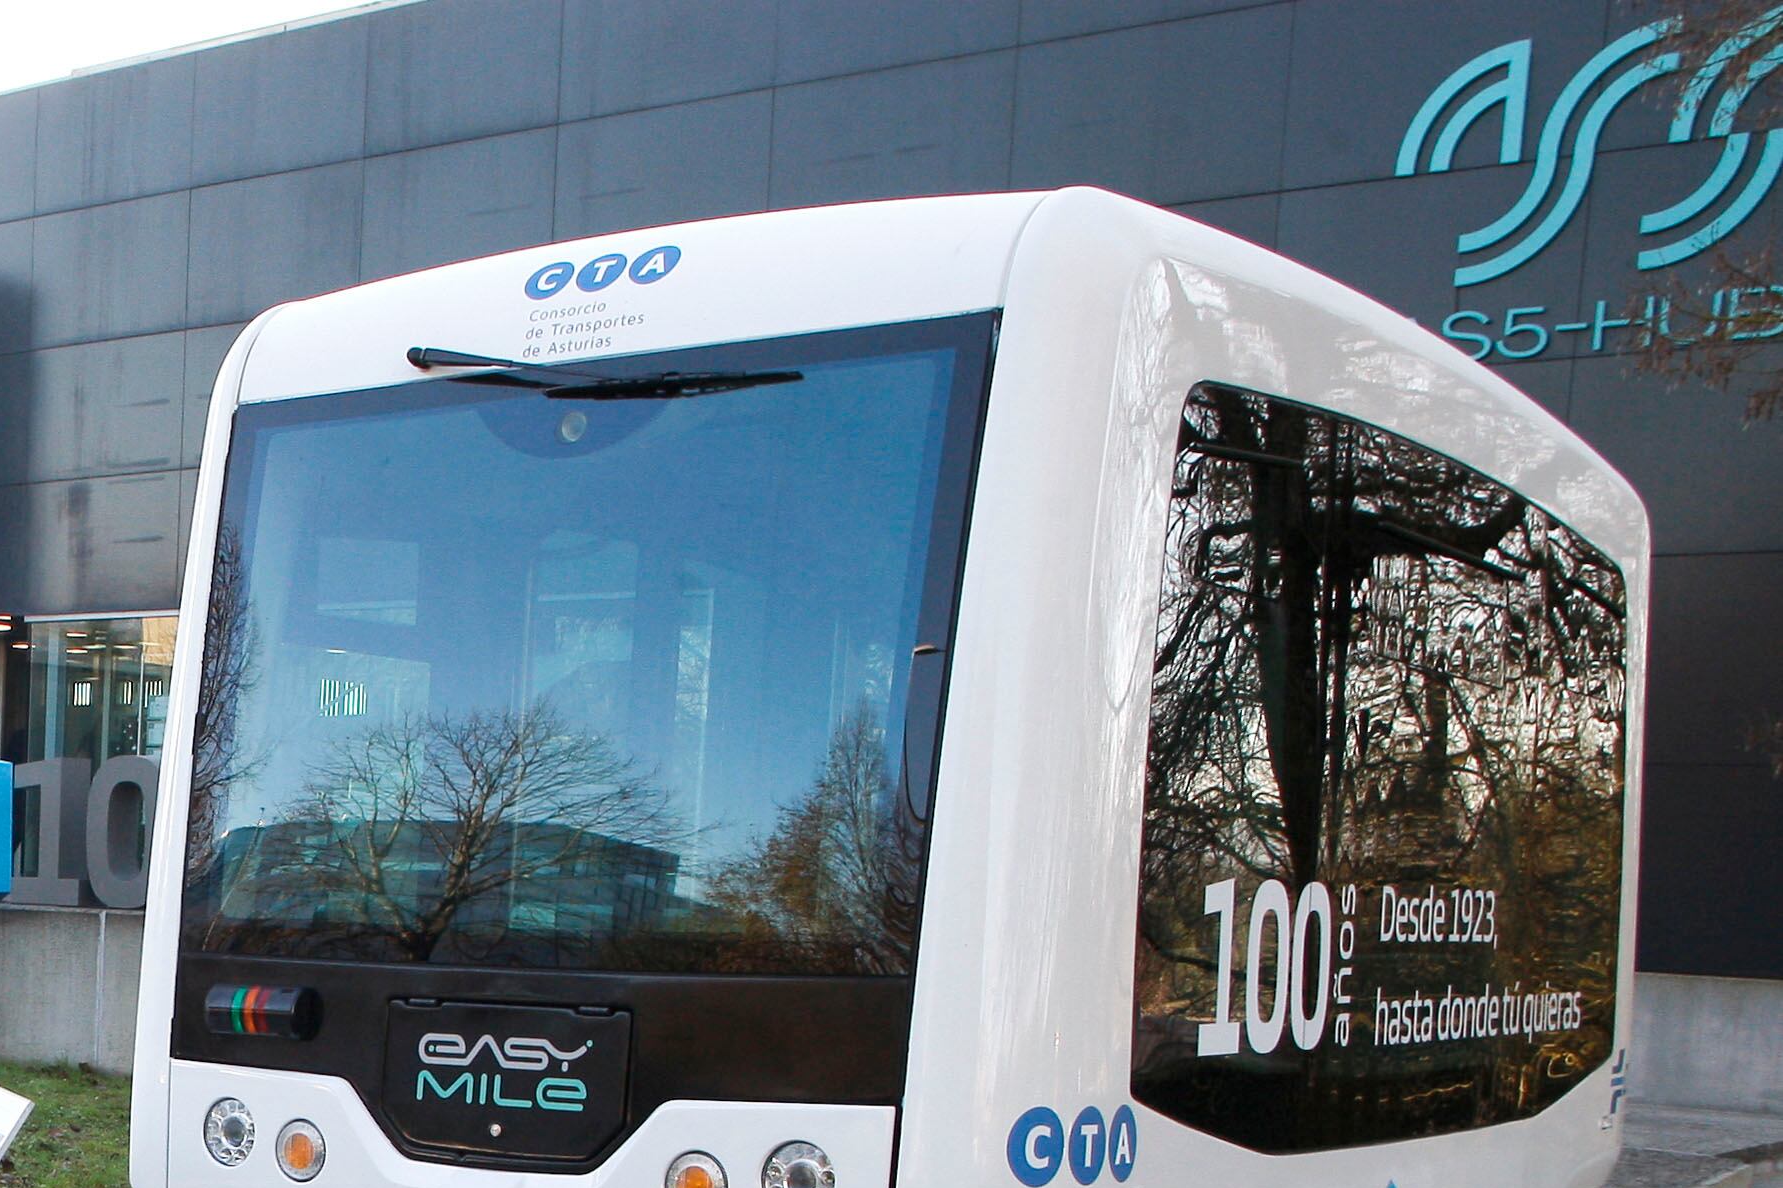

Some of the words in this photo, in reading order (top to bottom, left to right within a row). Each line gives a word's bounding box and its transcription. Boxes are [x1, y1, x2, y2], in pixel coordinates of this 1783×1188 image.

[530, 249, 674, 296] CTA
[525, 326, 543, 340] de
[551, 313, 645, 337] Transportes
[529, 301, 606, 322] Consorcio
[1441, 284, 1783, 361] S5-HUB
[522, 344, 540, 358] de
[547, 336, 612, 355] Asturias
[1379, 884, 1446, 942] Desde
[1448, 888, 1499, 950] 1923,
[1198, 878, 1331, 1056] 100
[1333, 883, 1356, 1047] años
[1374, 986, 1434, 1046] hasta
[1437, 983, 1499, 1041] donde
[1502, 980, 1521, 1036] tú
[1522, 980, 1582, 1044] quieras
[1015, 1112, 1134, 1180] CTA
